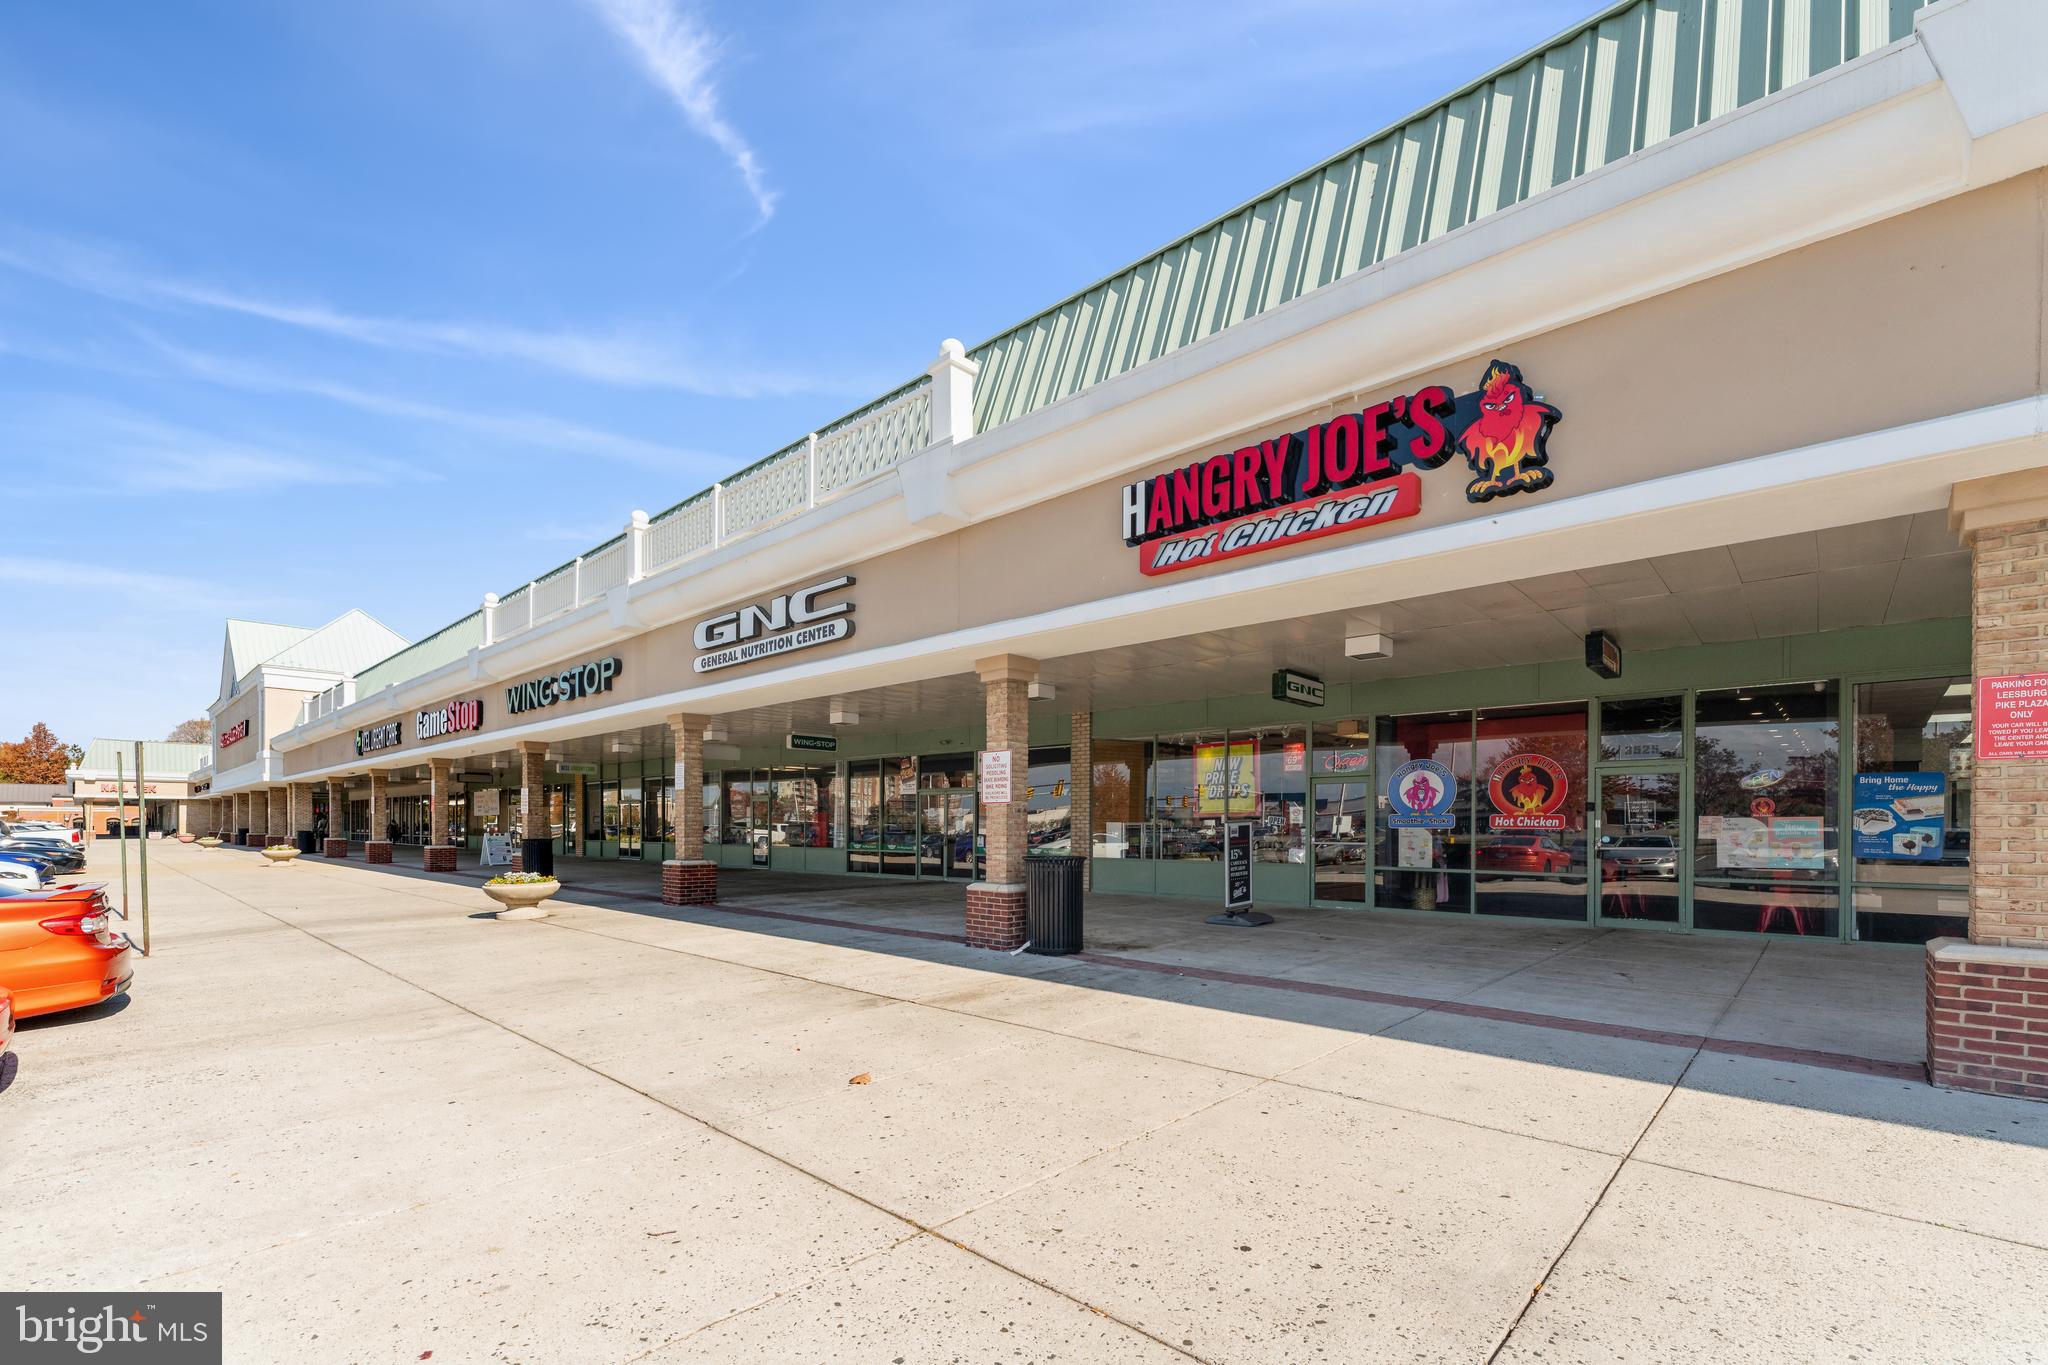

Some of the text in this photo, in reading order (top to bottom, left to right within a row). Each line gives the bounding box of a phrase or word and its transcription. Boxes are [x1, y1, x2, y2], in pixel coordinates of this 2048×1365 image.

[1122, 385, 1452, 540] HANGRY JOE'S
[1152, 488, 1399, 568] Hot Chicken
[693, 576, 856, 650] GNC
[701, 623, 835, 668] GENERAL NUTRITION CENTER
[1287, 681, 1325, 699] GNC
[1991, 678, 2048, 689] PARKING FO
[1997, 689, 2047, 699] LEESBURG
[2019, 699, 2048, 708] PLAZA
[416, 700, 481, 740] GameStop
[2010, 710, 2033, 718] ONLY
[1625, 744, 1659, 754] 3525
[1493, 756, 1531, 781] HANGRY
[1205, 770, 1239, 785] PRIE
[1860, 776, 1882, 784] Bring
[1906, 784, 1938, 792] Happy
[1495, 815, 1559, 827] Hot Chicken
